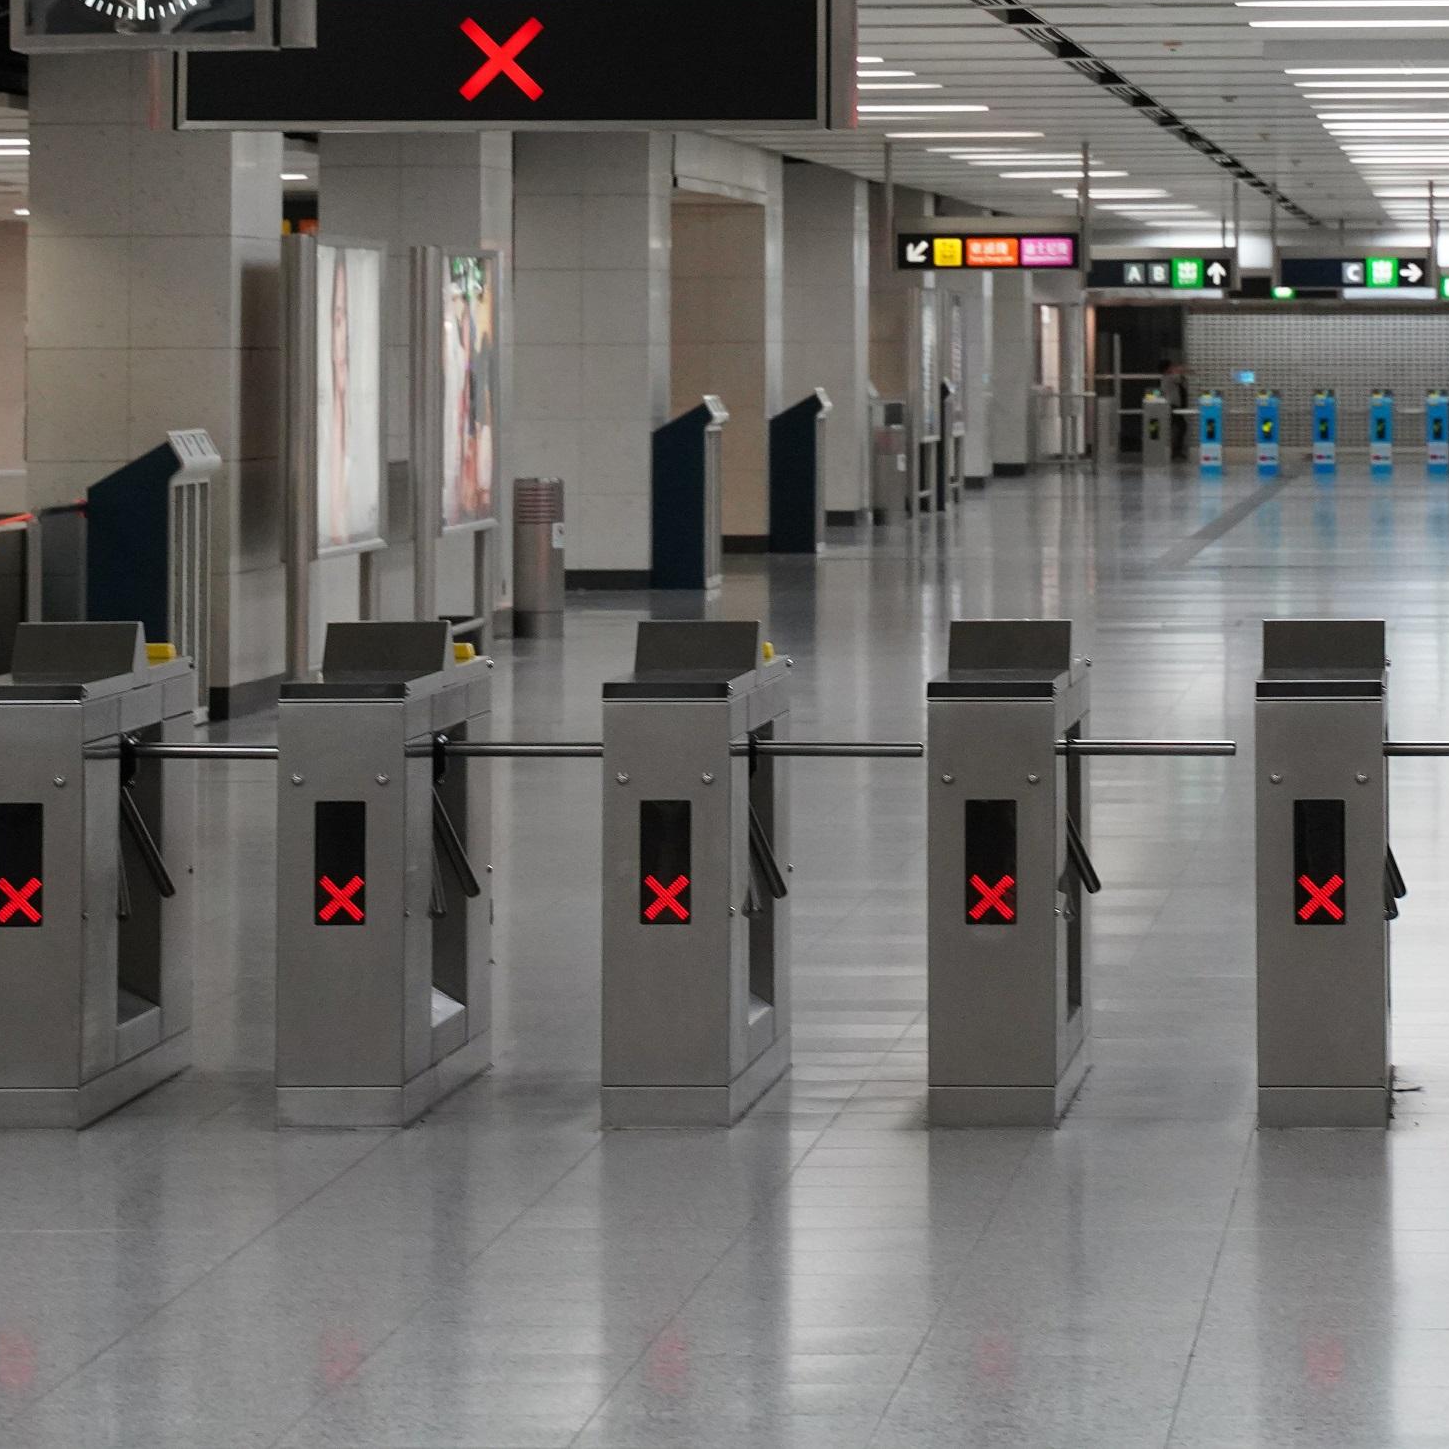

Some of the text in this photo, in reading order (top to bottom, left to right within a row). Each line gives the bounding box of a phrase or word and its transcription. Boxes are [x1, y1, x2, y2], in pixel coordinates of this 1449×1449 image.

[1128, 264, 1141, 282] A
[1153, 265, 1165, 282] B
[1346, 263, 1360, 281] C
